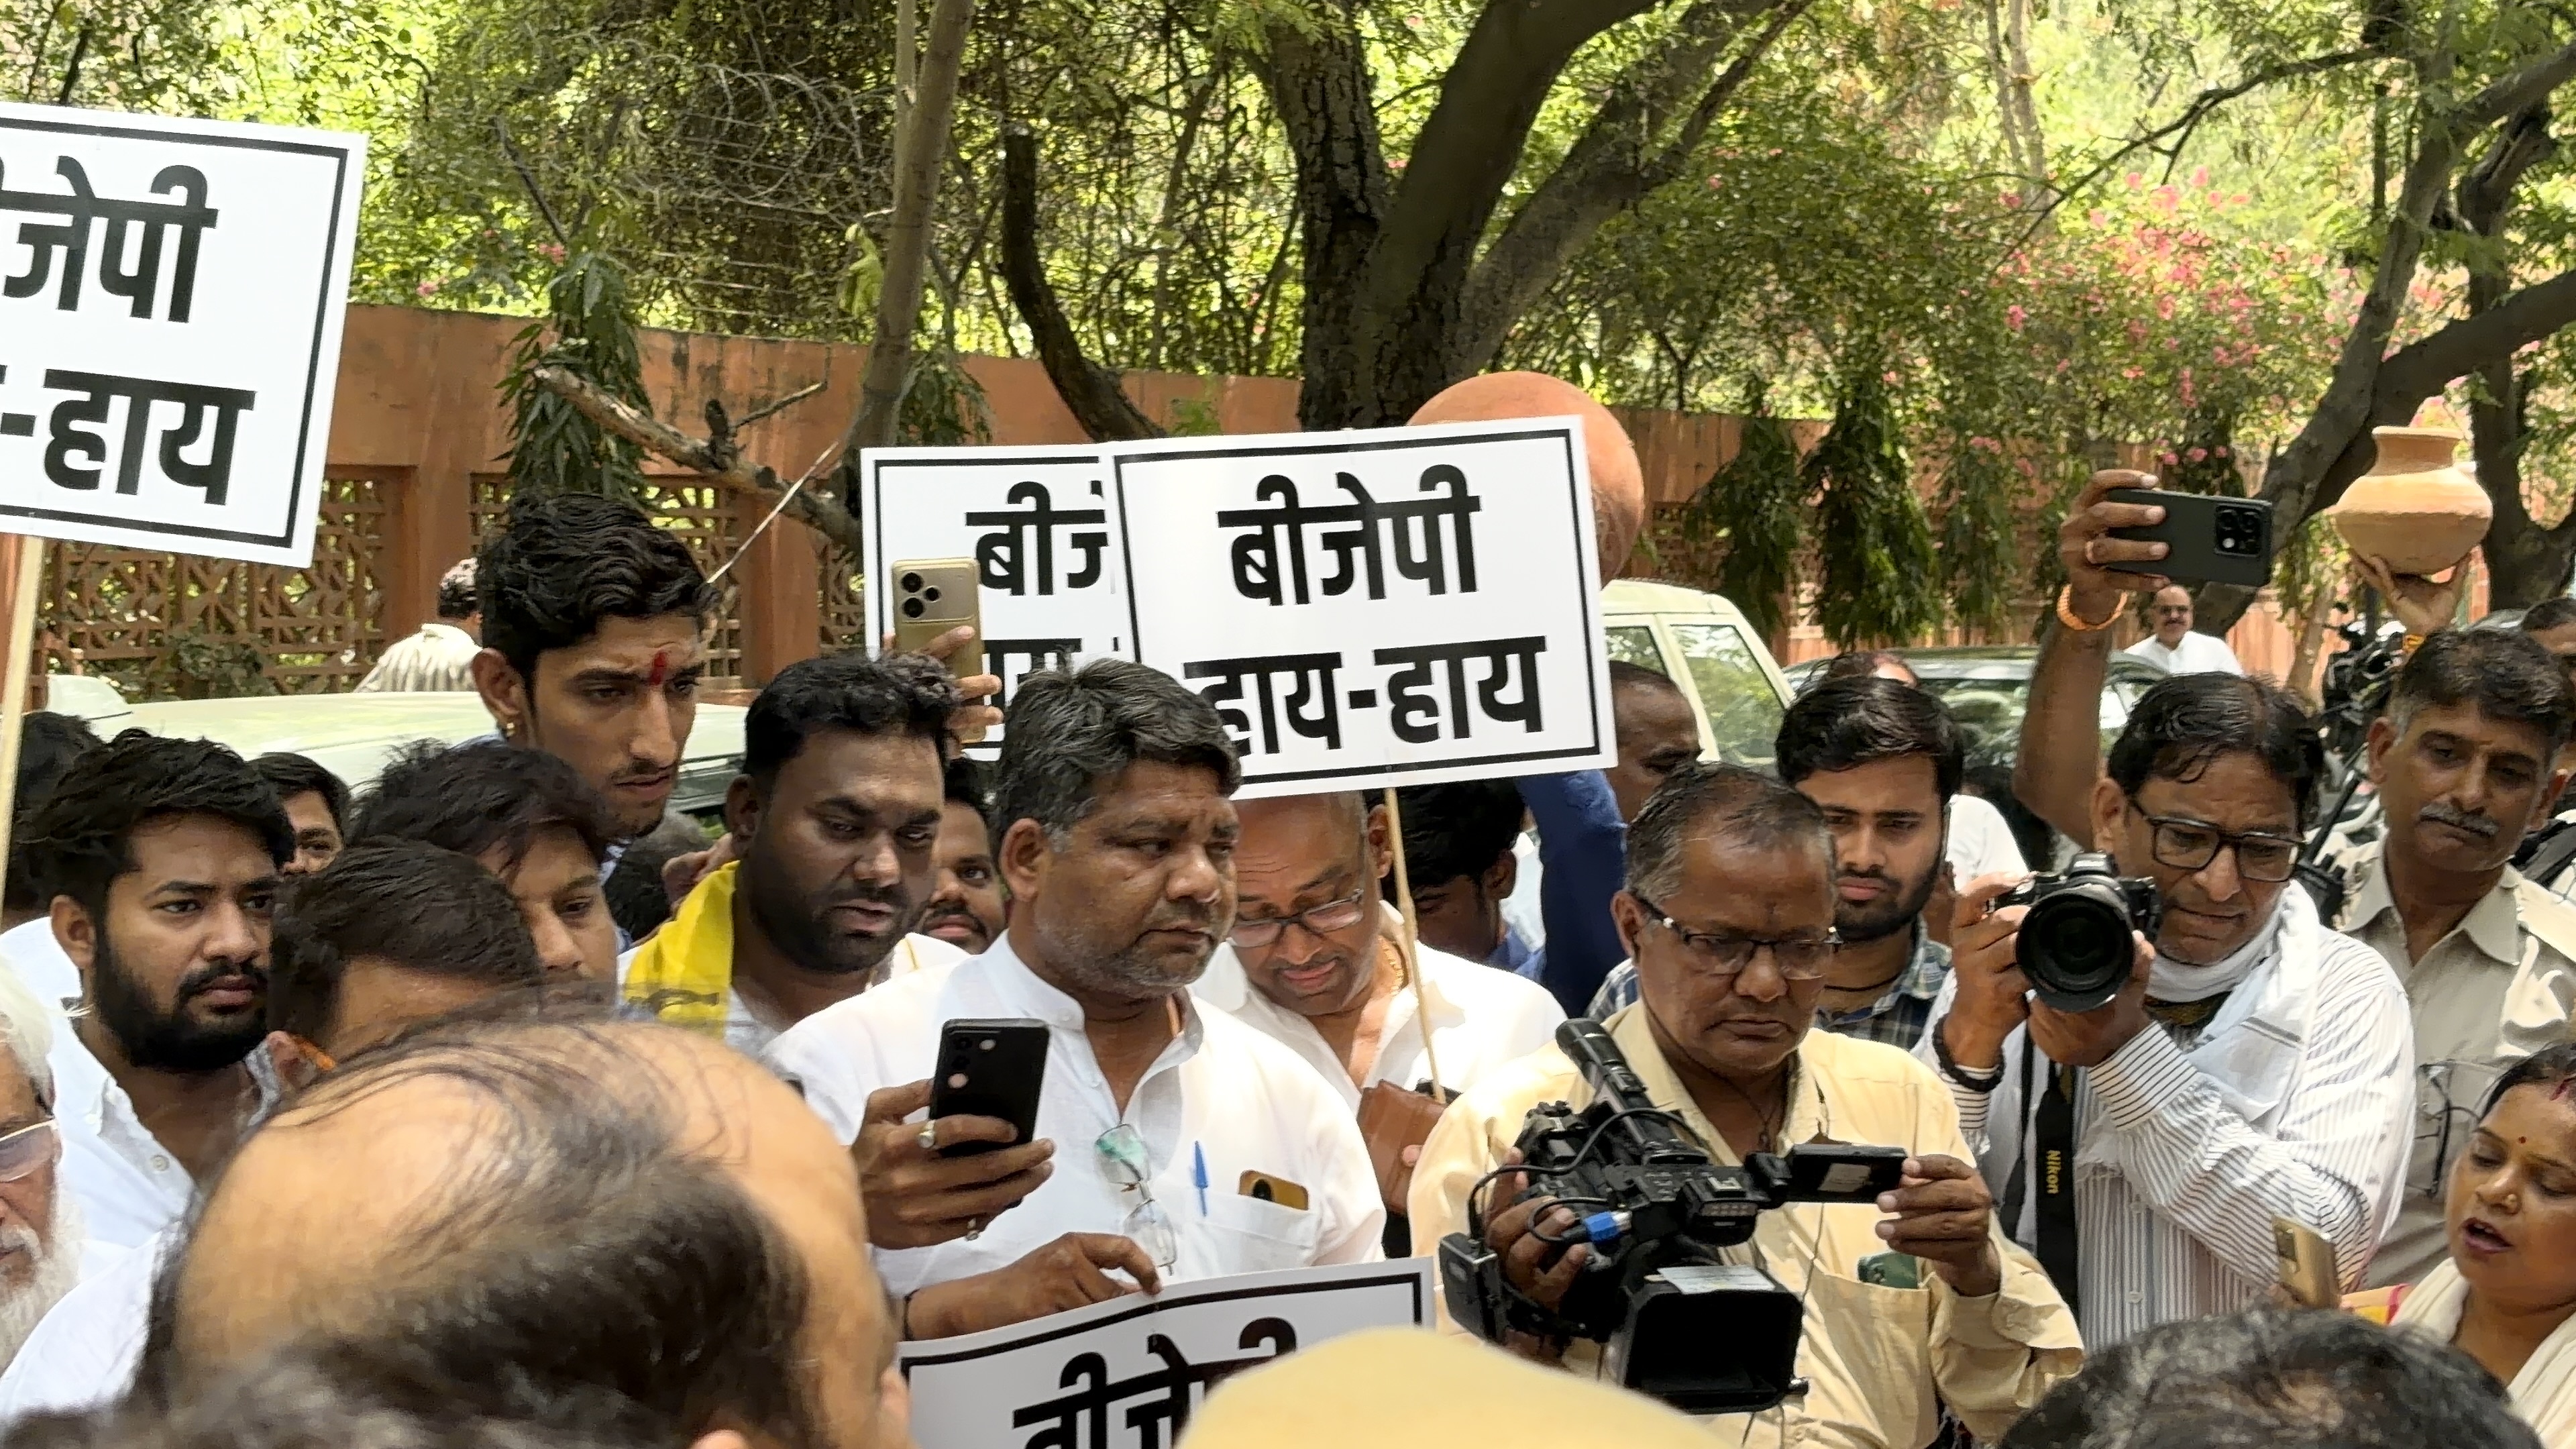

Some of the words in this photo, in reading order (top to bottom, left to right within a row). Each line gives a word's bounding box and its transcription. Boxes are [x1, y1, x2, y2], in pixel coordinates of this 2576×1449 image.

[0, 155, 219, 323] जेपी
[1217, 464, 1481, 606] बीजेपी
[1183, 635, 1546, 756] हाय-हाय
[2046, 1150, 2061, 1194] Nikon
